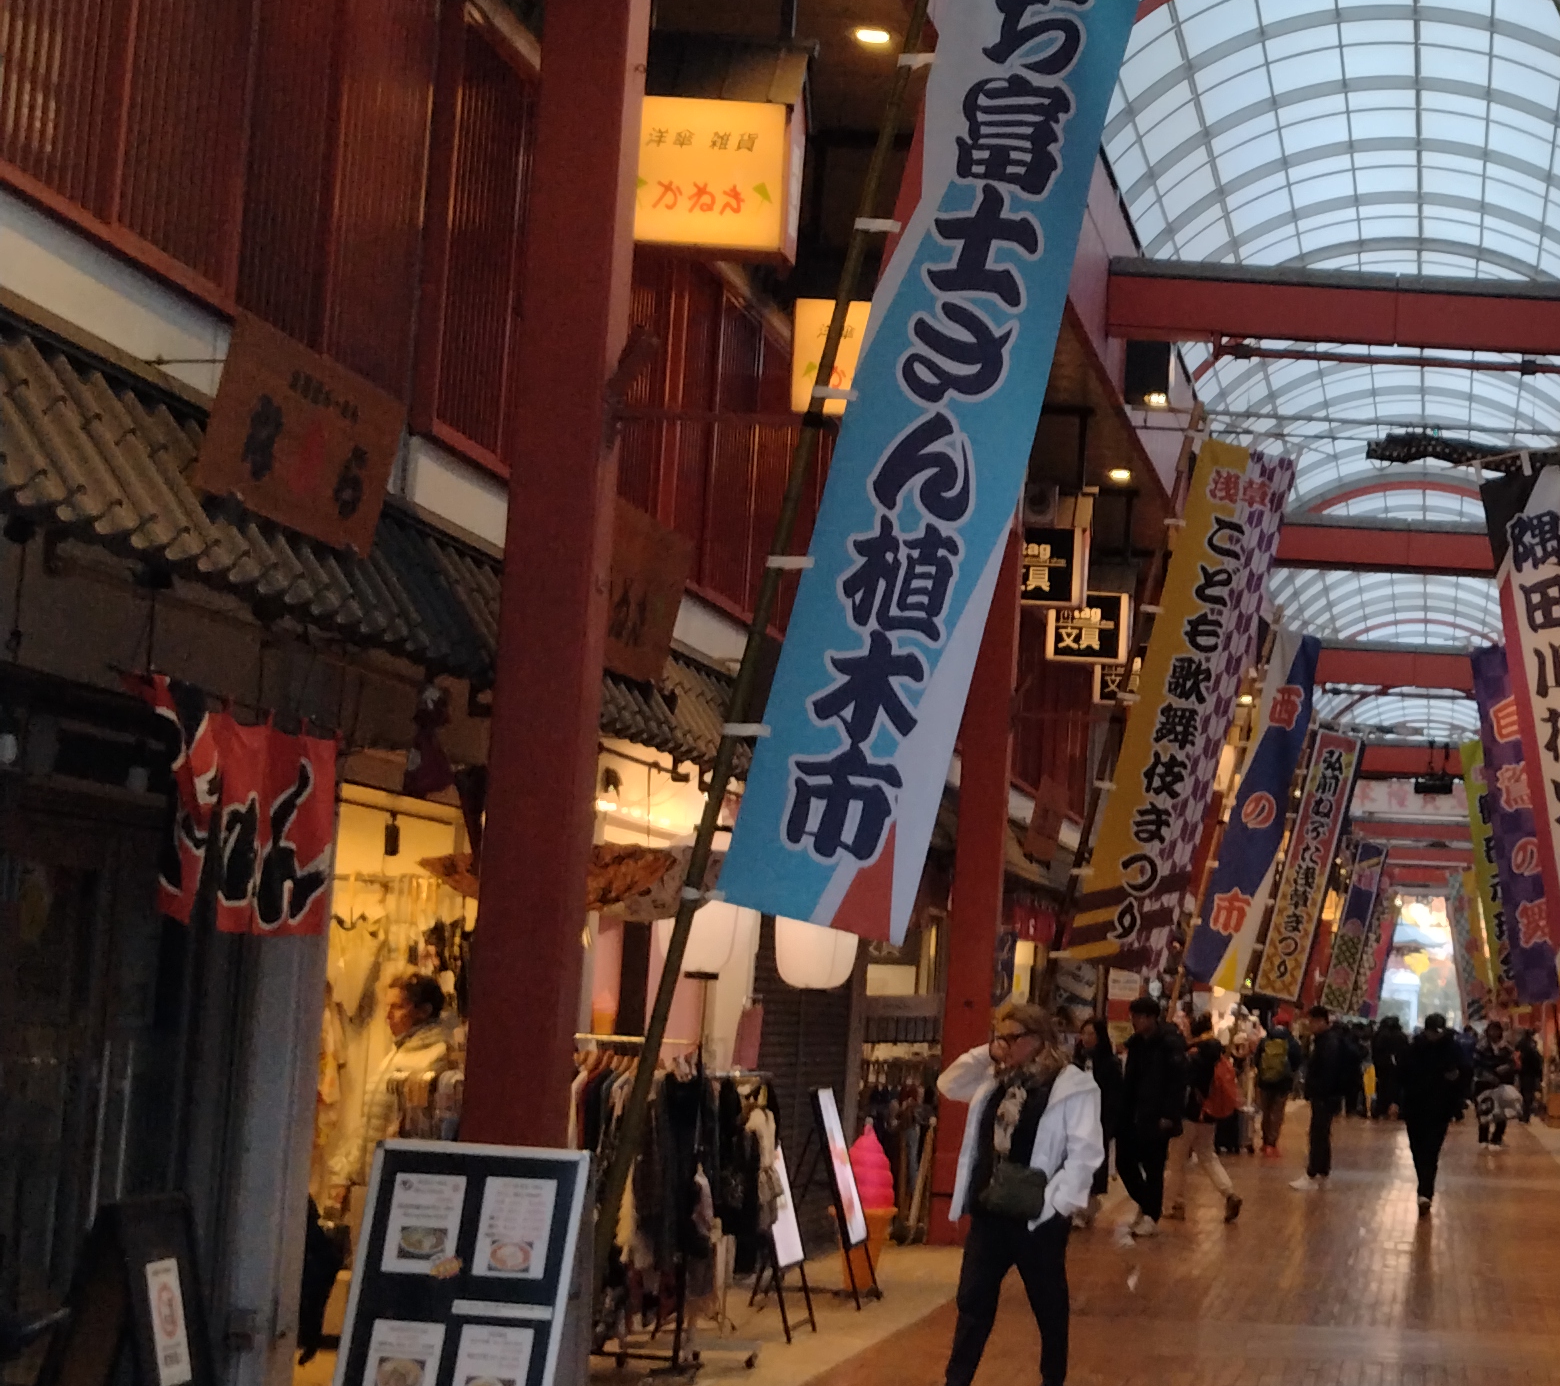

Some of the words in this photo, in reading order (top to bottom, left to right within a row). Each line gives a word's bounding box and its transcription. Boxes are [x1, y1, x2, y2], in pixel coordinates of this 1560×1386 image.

[651, 180, 745, 216] かねき
[1209, 469, 1271, 507] 浅草
[1057, 626, 1101, 651] 文具
[1109, 515, 1246, 942] こども歌舞伎まつり
